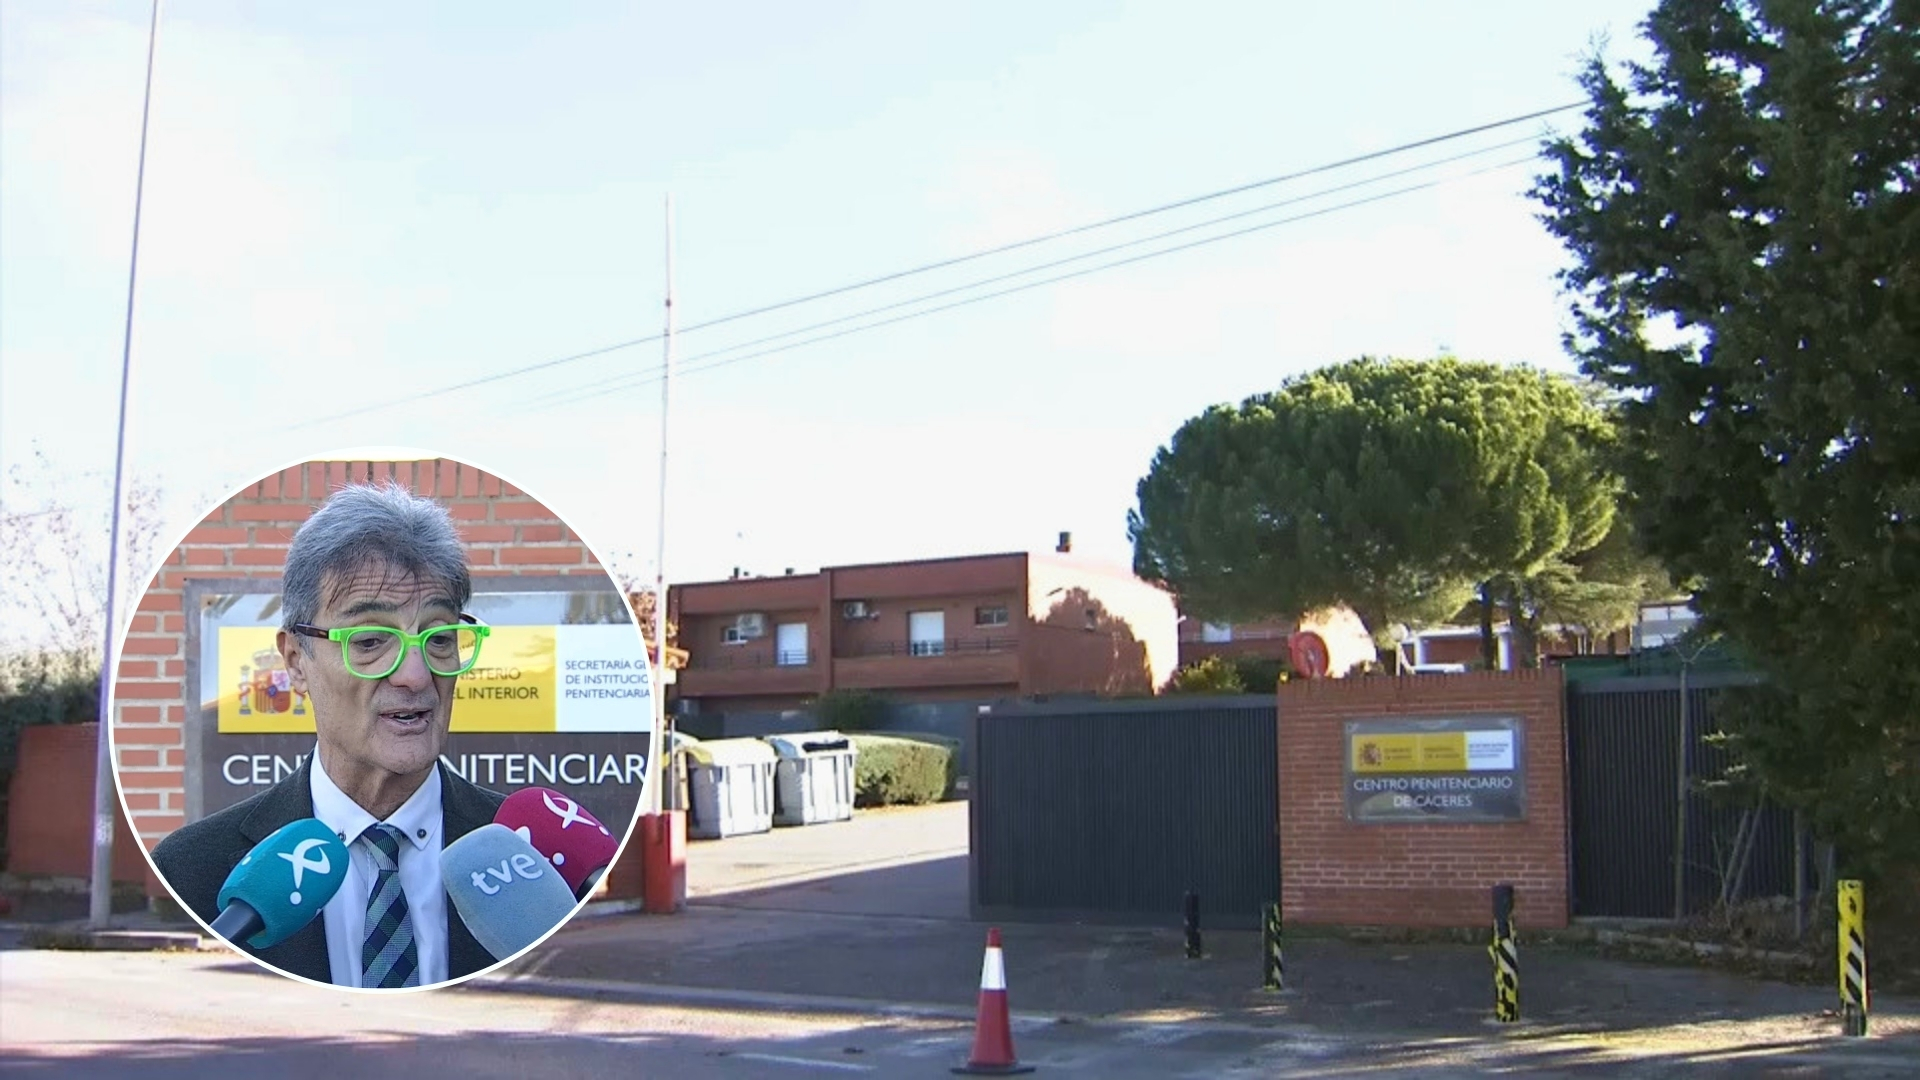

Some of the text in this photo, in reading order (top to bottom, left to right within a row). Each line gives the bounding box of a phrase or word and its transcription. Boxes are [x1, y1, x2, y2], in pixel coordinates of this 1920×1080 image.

[565, 658, 631, 670] SECRETARÍA
[565, 674, 581, 684] DE
[468, 686, 539, 700] INTERIOR
[1354, 776, 1513, 791] CENTRO PENITENCIARIO
[1393, 795, 1411, 808] DE
[470, 853, 544, 896] tve
